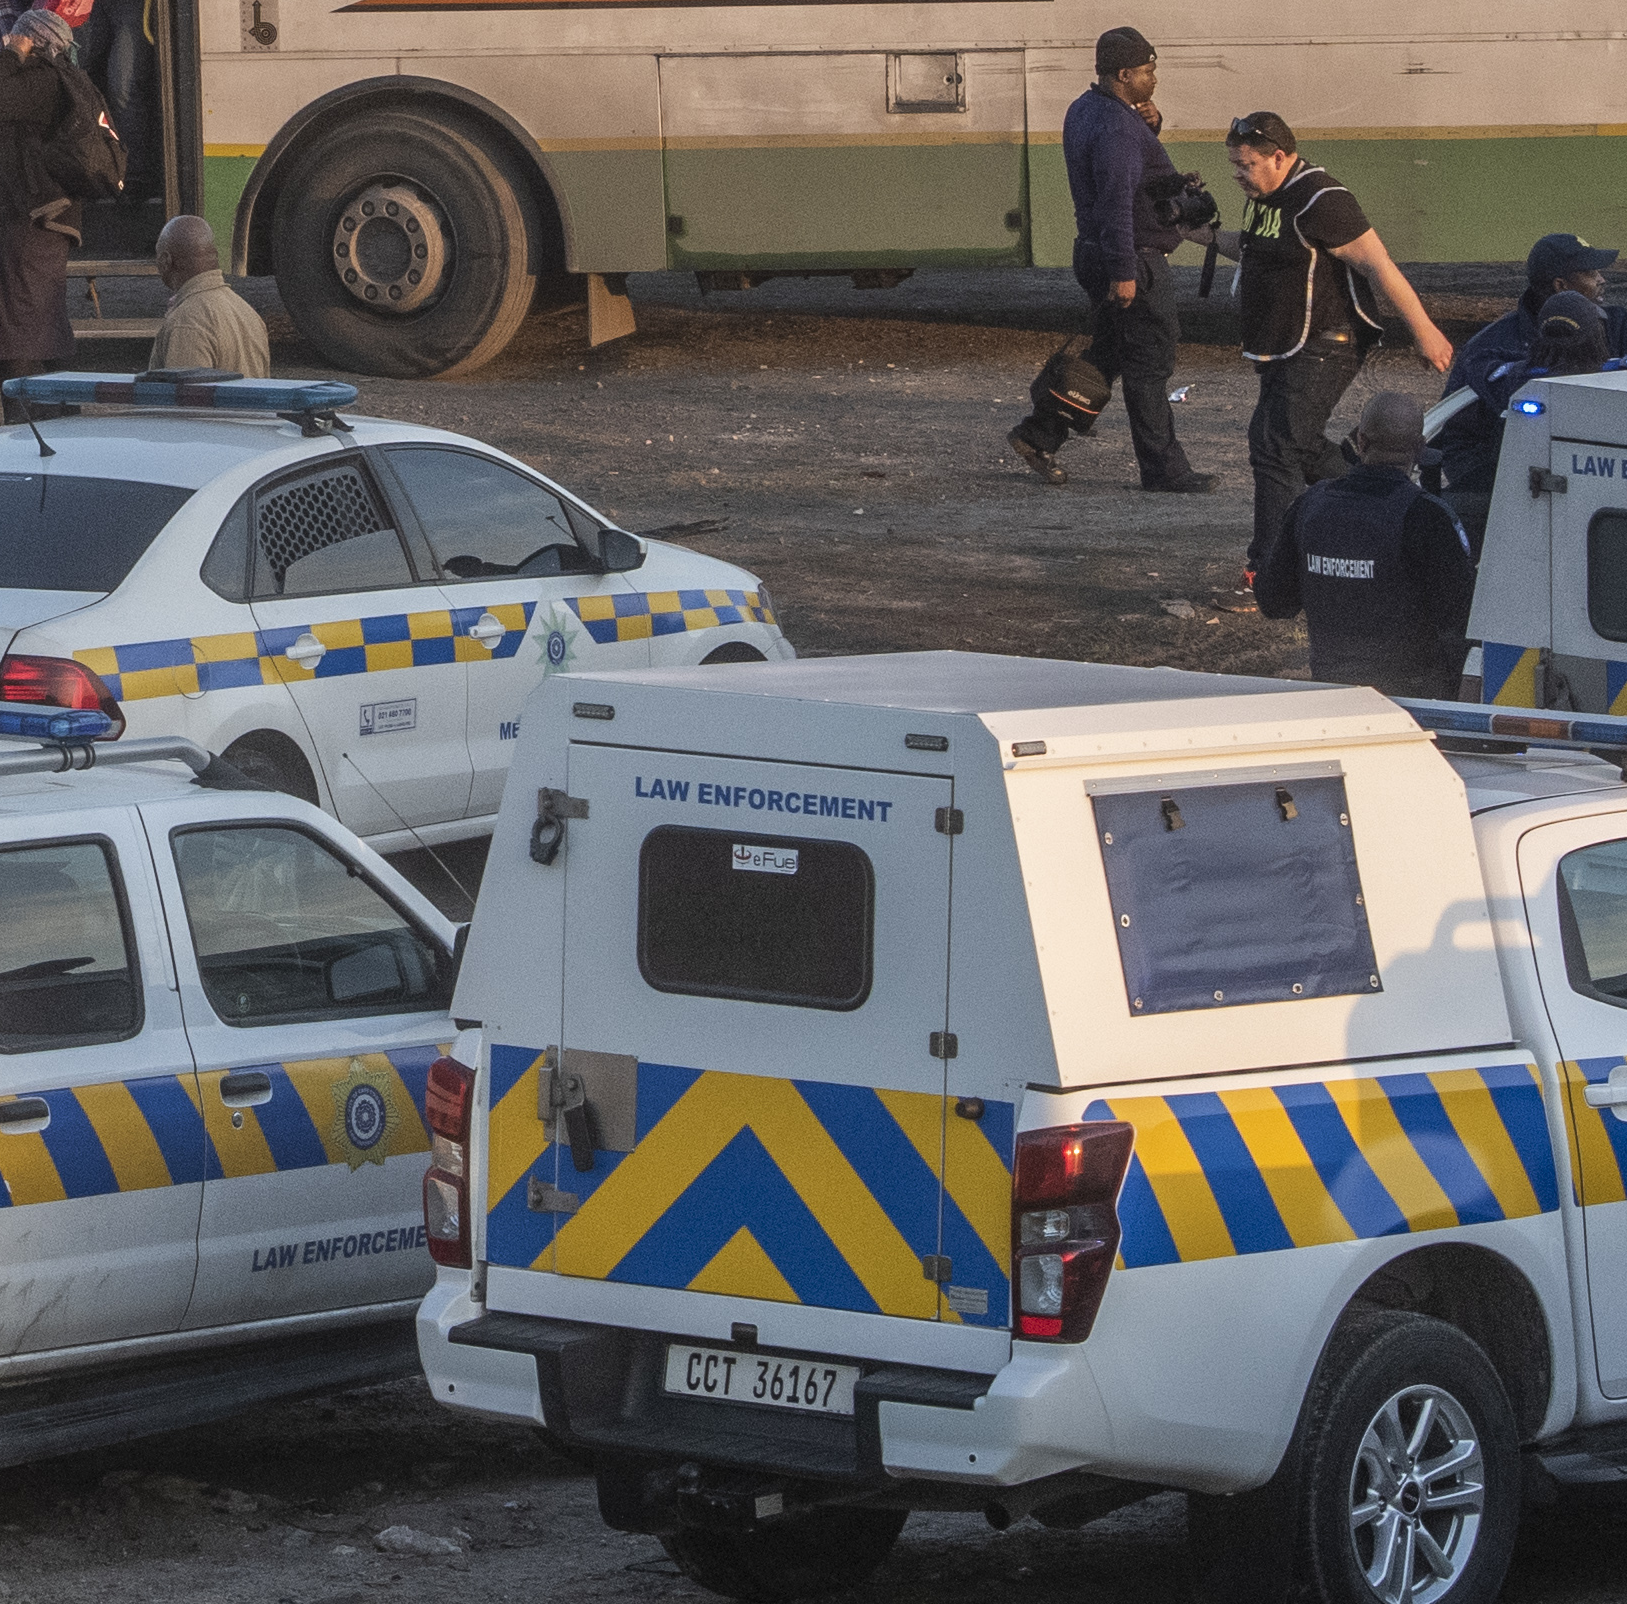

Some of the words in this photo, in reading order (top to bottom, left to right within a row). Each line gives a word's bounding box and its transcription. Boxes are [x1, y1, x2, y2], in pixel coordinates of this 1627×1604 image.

[1571, 454, 1616, 479] LAW
[1307, 553, 1321, 574] LAW
[1322, 556, 1375, 579] ENFORCEMENT
[634, 775, 689, 801] LAW
[698, 781, 893, 825] ENFORCEMENT
[251, 1243, 301, 1272] LAW
[302, 1225, 427, 1264] ENFORCEME
[685, 1352, 737, 1398] CCT
[752, 1359, 838, 1409] 36167
